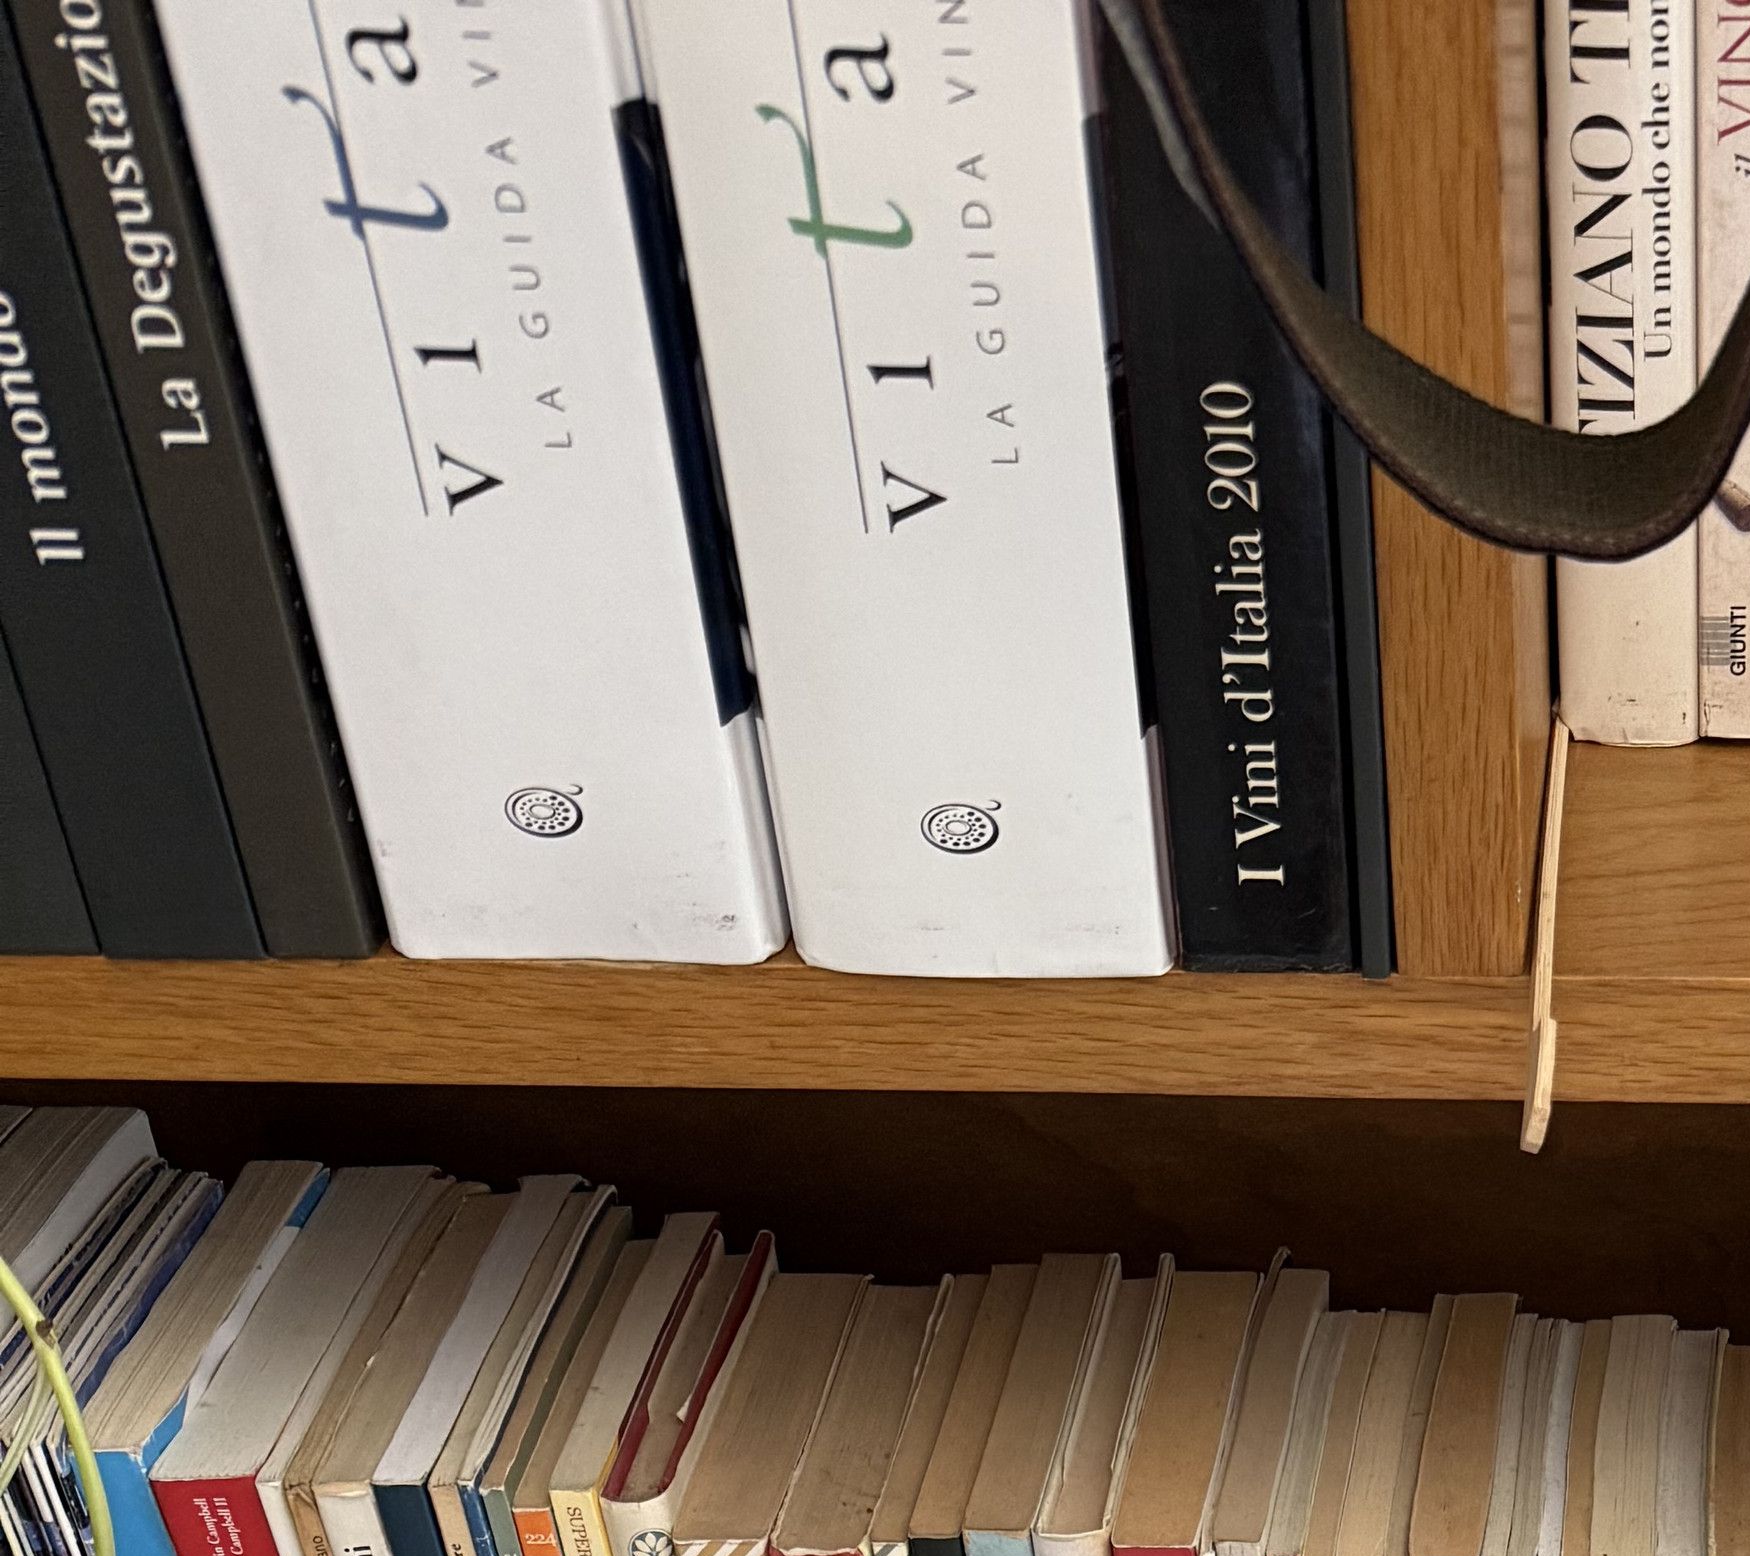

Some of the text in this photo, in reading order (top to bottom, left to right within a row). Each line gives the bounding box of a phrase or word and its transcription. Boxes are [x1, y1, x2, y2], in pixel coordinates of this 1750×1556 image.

[1640, 83, 1671, 151] che
[485, 136, 549, 340] GUIDA
[956, 153, 1006, 354] GUIDA
[1641, 161, 1672, 293] mondo
[1570, 114, 1636, 434] IZIANO
[1643, 305, 1672, 362] Un
[158, 377, 211, 451] La
[536, 387, 573, 450] LA
[986, 403, 1019, 464] LA
[30, 528, 84, 564] Il
[1201, 379, 1285, 886] I Vini d'Italia 2010
[1730, 604, 1748, 677] GIUNTI
[193, 1498, 220, 1544] Campbell
[218, 1509, 244, 1555] Campbell
